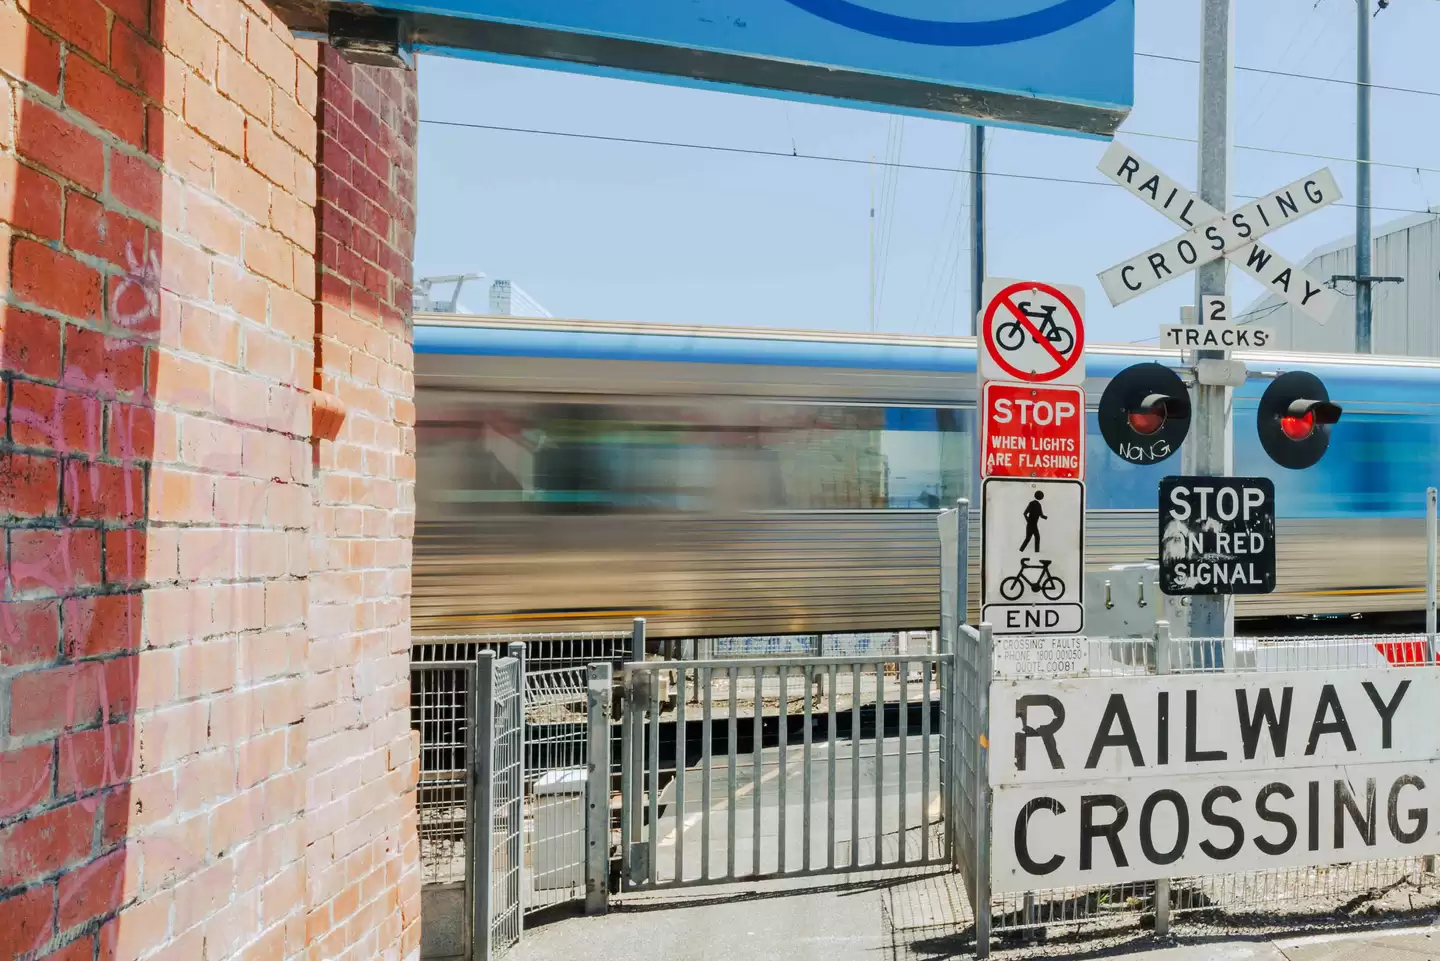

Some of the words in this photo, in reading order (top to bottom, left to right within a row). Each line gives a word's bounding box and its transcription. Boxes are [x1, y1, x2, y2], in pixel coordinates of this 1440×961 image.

[1117, 155, 1194, 227] RAIL
[1247, 244, 1321, 307] WAY
[1121, 180, 1324, 291] CROSSING
[1209, 300, 1227, 321] 2
[1171, 328, 1266, 347] TRACKS
[992, 398, 1076, 427] STOP
[991, 435, 1026, 450] WHEN
[1032, 436, 1075, 452] LIGHTS
[987, 452, 1013, 467] ARE
[1018, 453, 1079, 469] FLASHING
[1169, 486, 1266, 522] STOP
[1216, 532, 1265, 555] RED
[1174, 563, 1263, 586] SIGNAL
[1007, 610, 1059, 628] END
[1003, 640, 1043, 650] CROSSING
[1052, 639, 1081, 649] FAULTS
[1004, 651, 1030, 661] PHONE
[1014, 679, 1413, 772] RAILWAY
[1013, 773, 1430, 877] CROSSING
